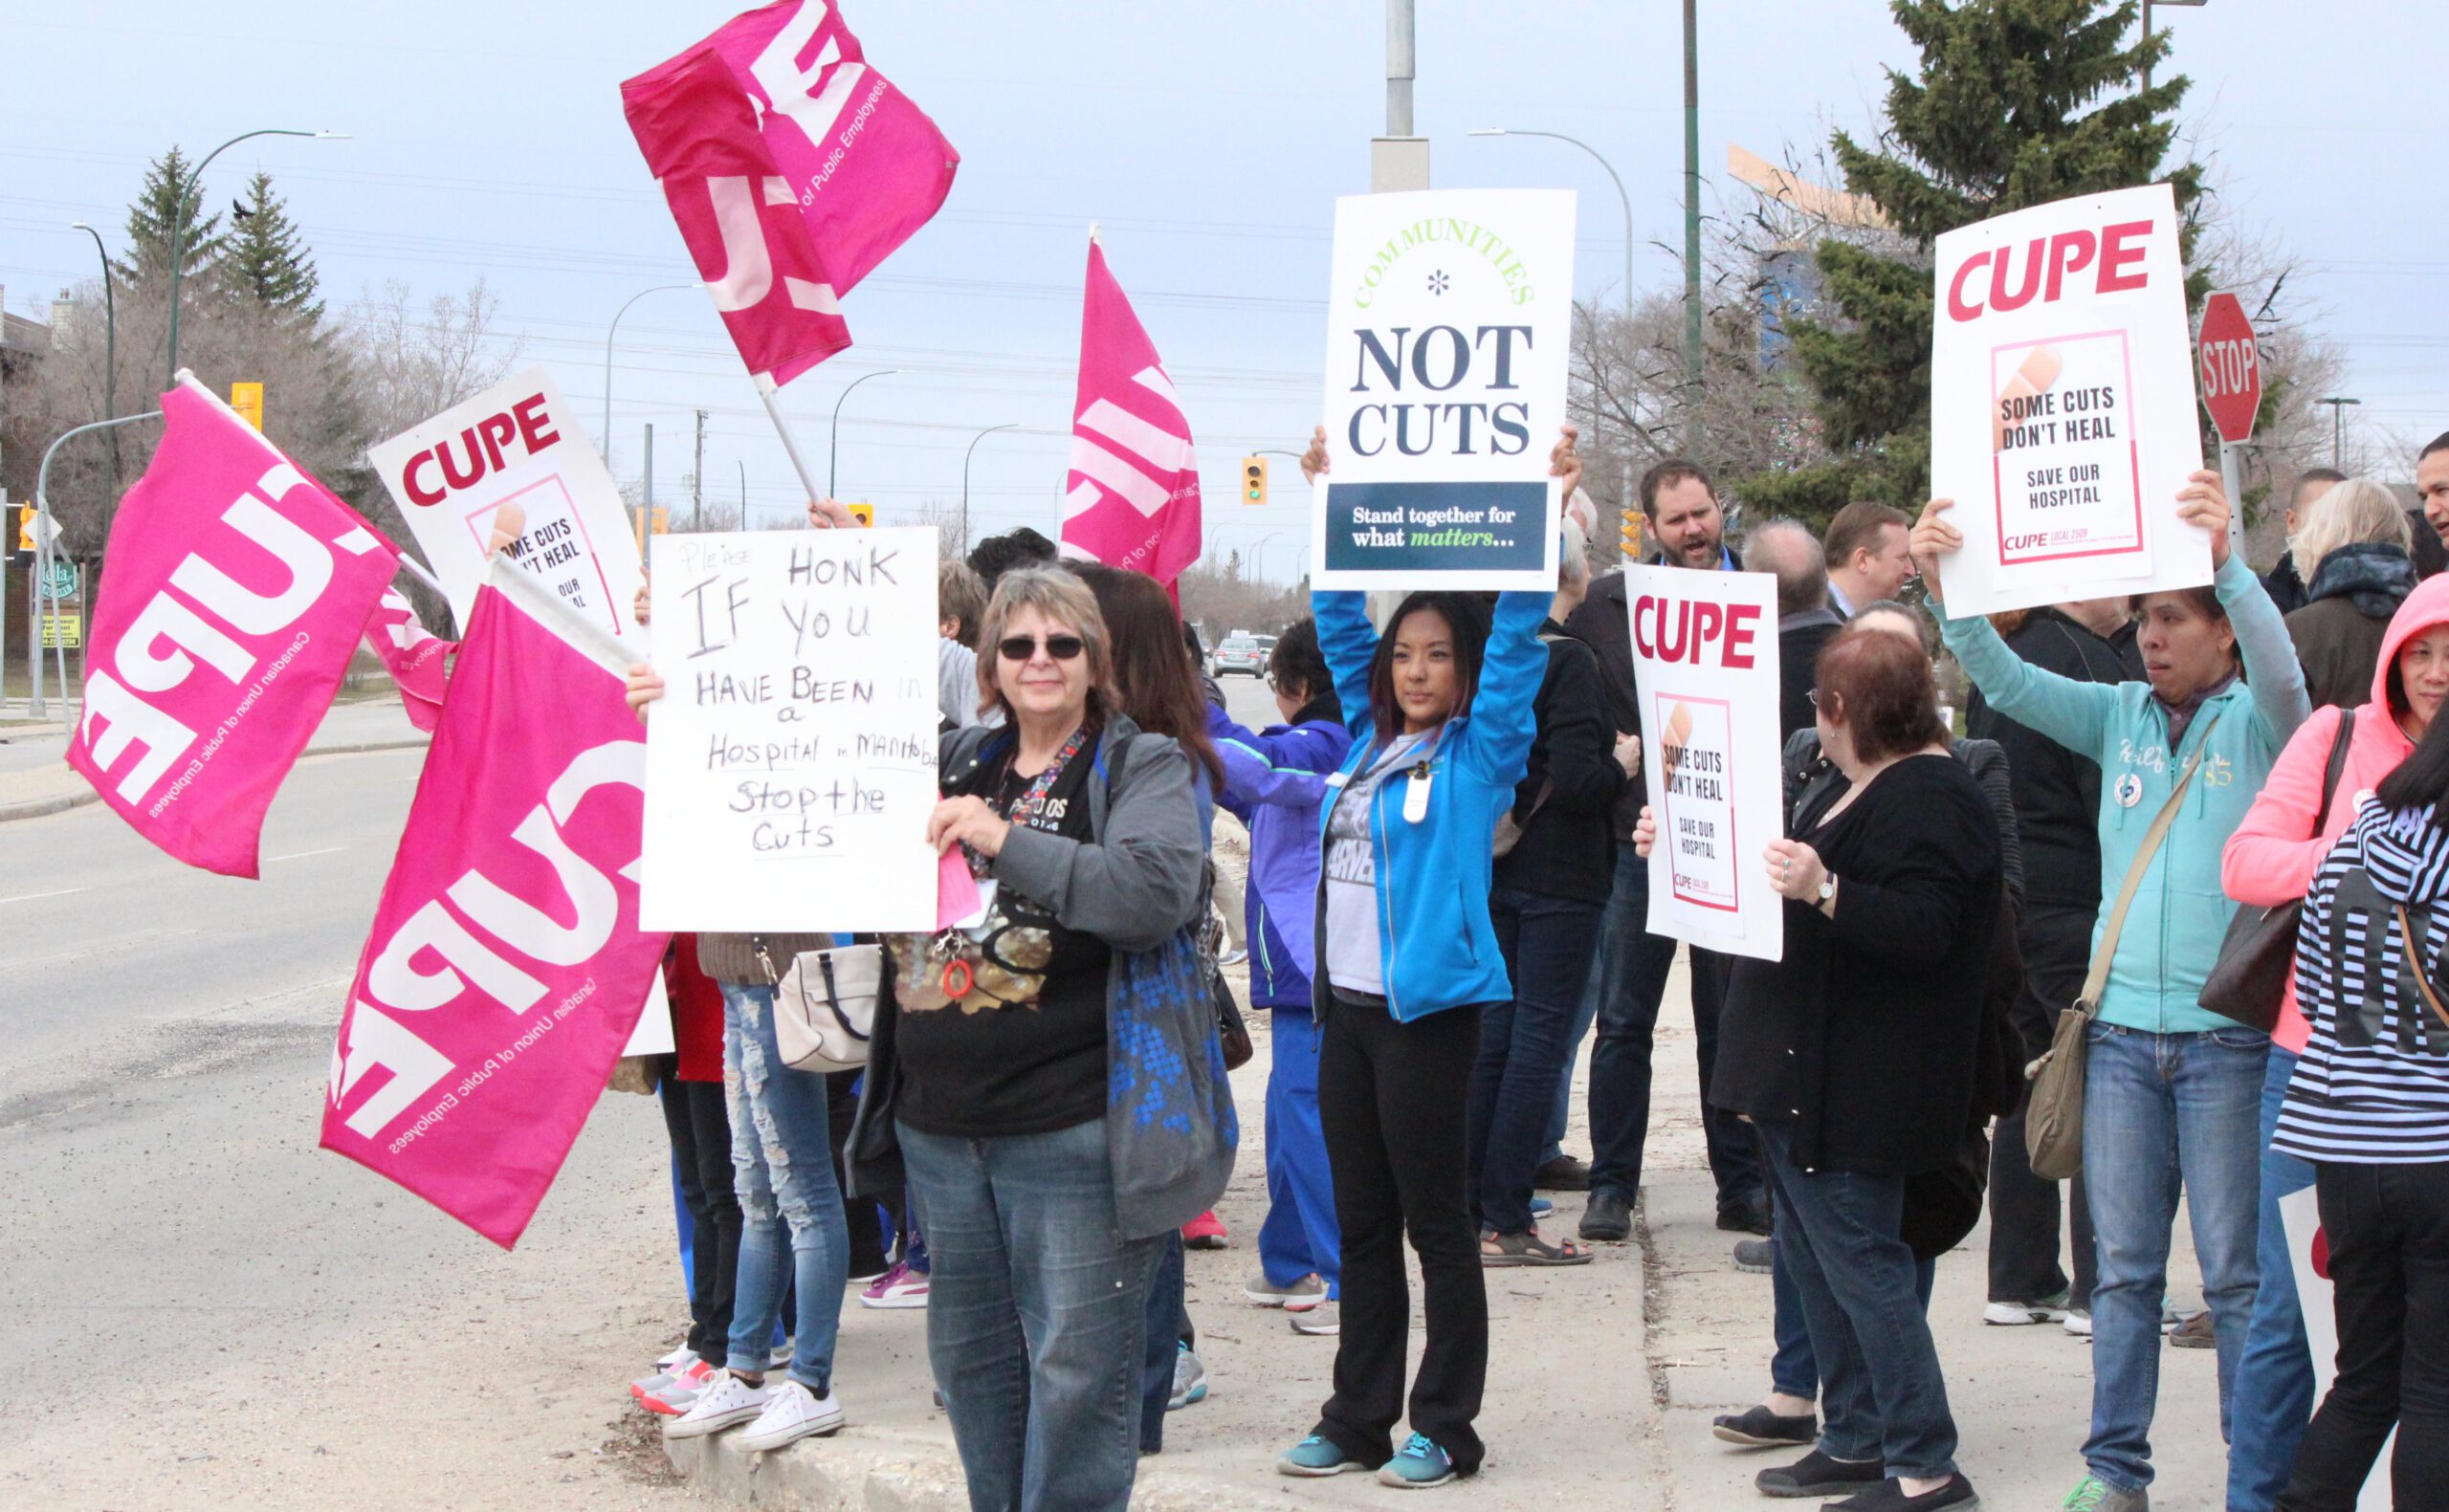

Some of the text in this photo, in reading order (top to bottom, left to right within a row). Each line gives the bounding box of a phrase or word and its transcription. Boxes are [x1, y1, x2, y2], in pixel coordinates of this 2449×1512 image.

[801, 78, 888, 207] of Public Employees
[1355, 217, 1535, 310] COMMUNITIES
[1947, 219, 2154, 323] CUPE
[1350, 324, 1533, 393] NOT
[2202, 339, 2256, 399] STOP
[2000, 386, 2115, 422] SOME CUTS
[1348, 402, 1531, 457] CUTS
[2002, 416, 2116, 451] DON'T HEAL
[402, 391, 562, 507] CUPE
[2027, 464, 2100, 488] SAVE OUR
[2029, 486, 2102, 510] HOSPITAL
[1353, 506, 1516, 527] Stand together for
[500, 518, 571, 560] OME CUTS
[1352, 527, 1514, 547] what matters...
[2004, 533, 2049, 552] CUPE
[543, 540, 581, 569] HEAL
[787, 543, 901, 586] HONK
[558, 578, 581, 597] OUR
[680, 575, 751, 659] IF
[1634, 595, 1762, 669] CUPE
[695, 671, 774, 707] HAVE
[791, 666, 873, 705] BEEN
[777, 705, 806, 723] a
[836, 745, 849, 757] in
[1663, 745, 1722, 774] SOME CUTS
[728, 776, 887, 814] Stop the
[1666, 772, 1724, 801] DON'T HEAL
[752, 818, 835, 851] Cuts
[1679, 817, 1715, 838] SAVE OUR
[1681, 838, 1716, 860] HOSPITAL
[1674, 872, 1692, 890] CUPE
